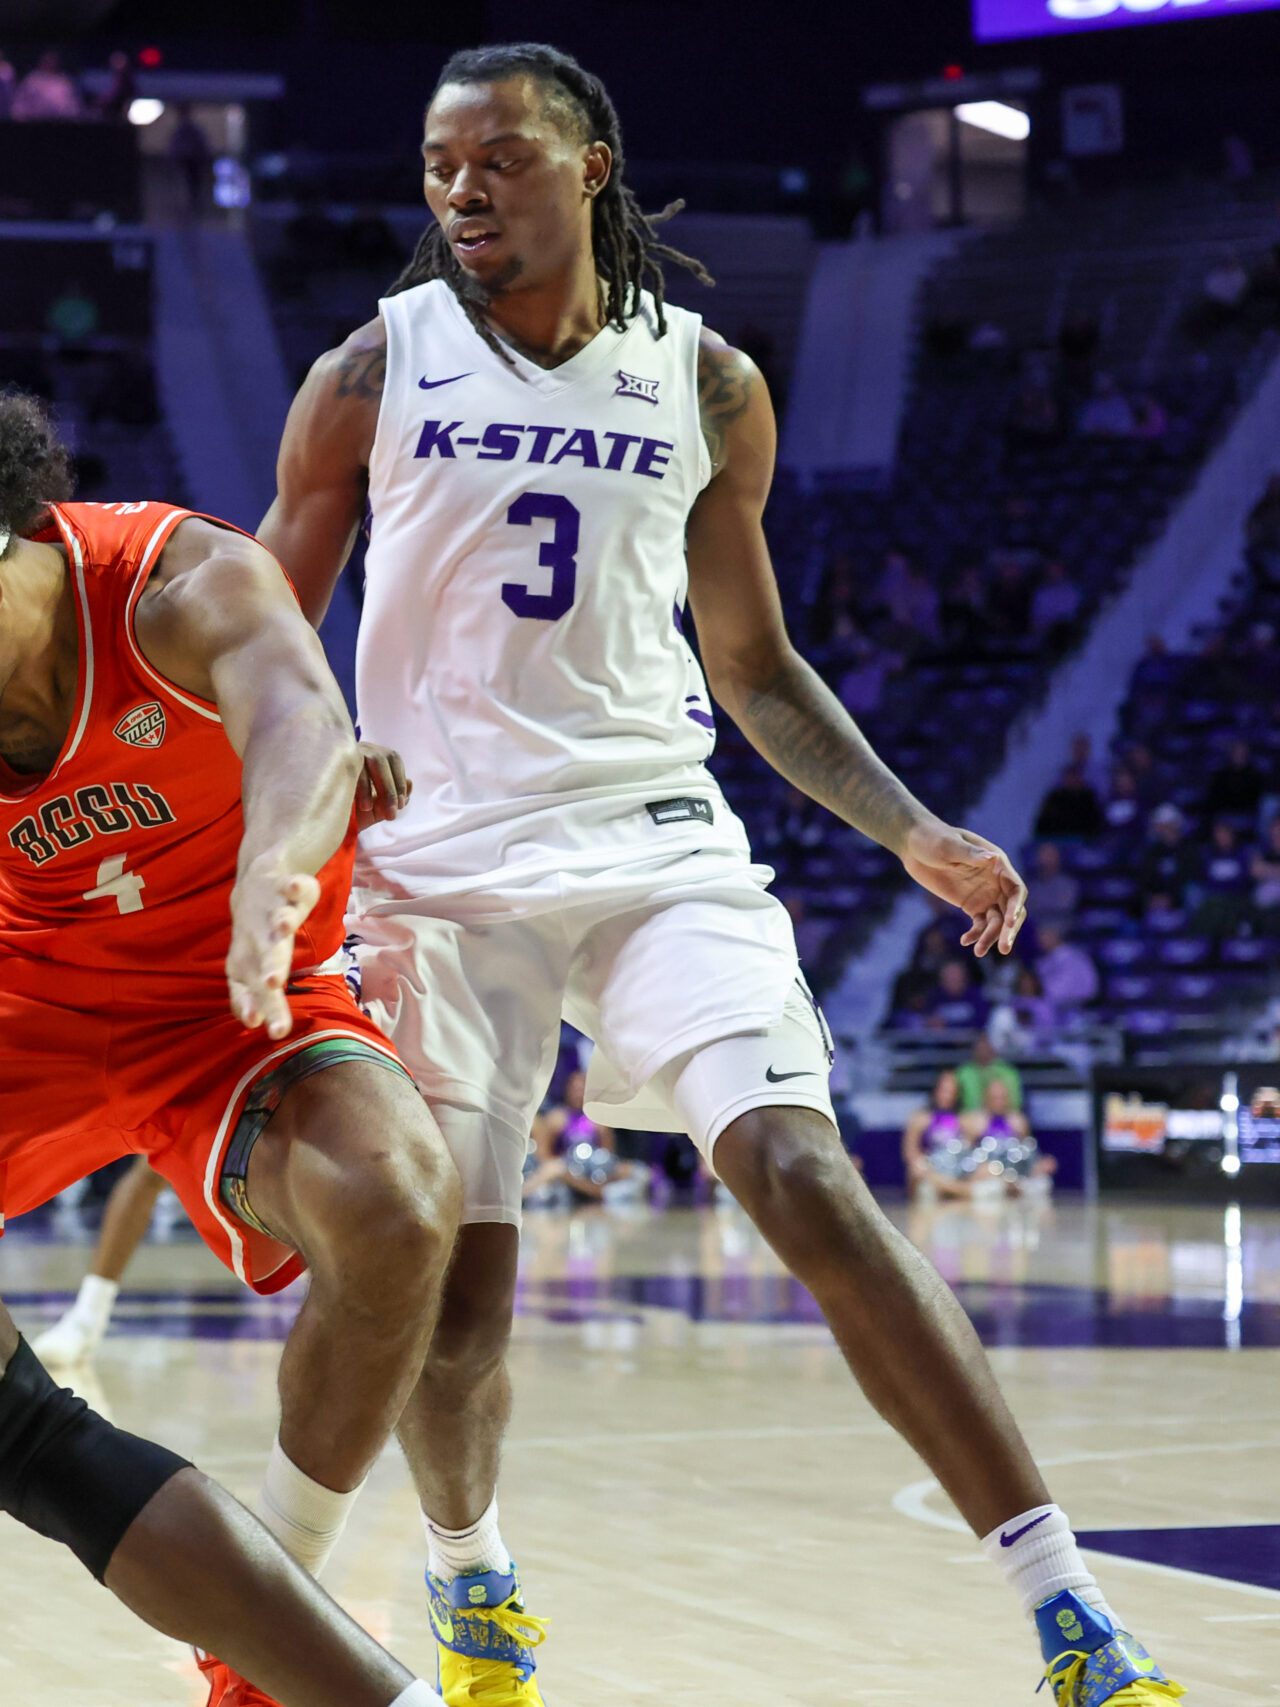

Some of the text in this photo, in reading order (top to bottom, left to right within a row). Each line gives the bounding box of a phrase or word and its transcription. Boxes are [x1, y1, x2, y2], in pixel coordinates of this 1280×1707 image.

[413, 420, 674, 480] K-STATE
[501, 491, 580, 621] 3
[123, 711, 165, 744] MAC
[82, 852, 146, 915] 4
